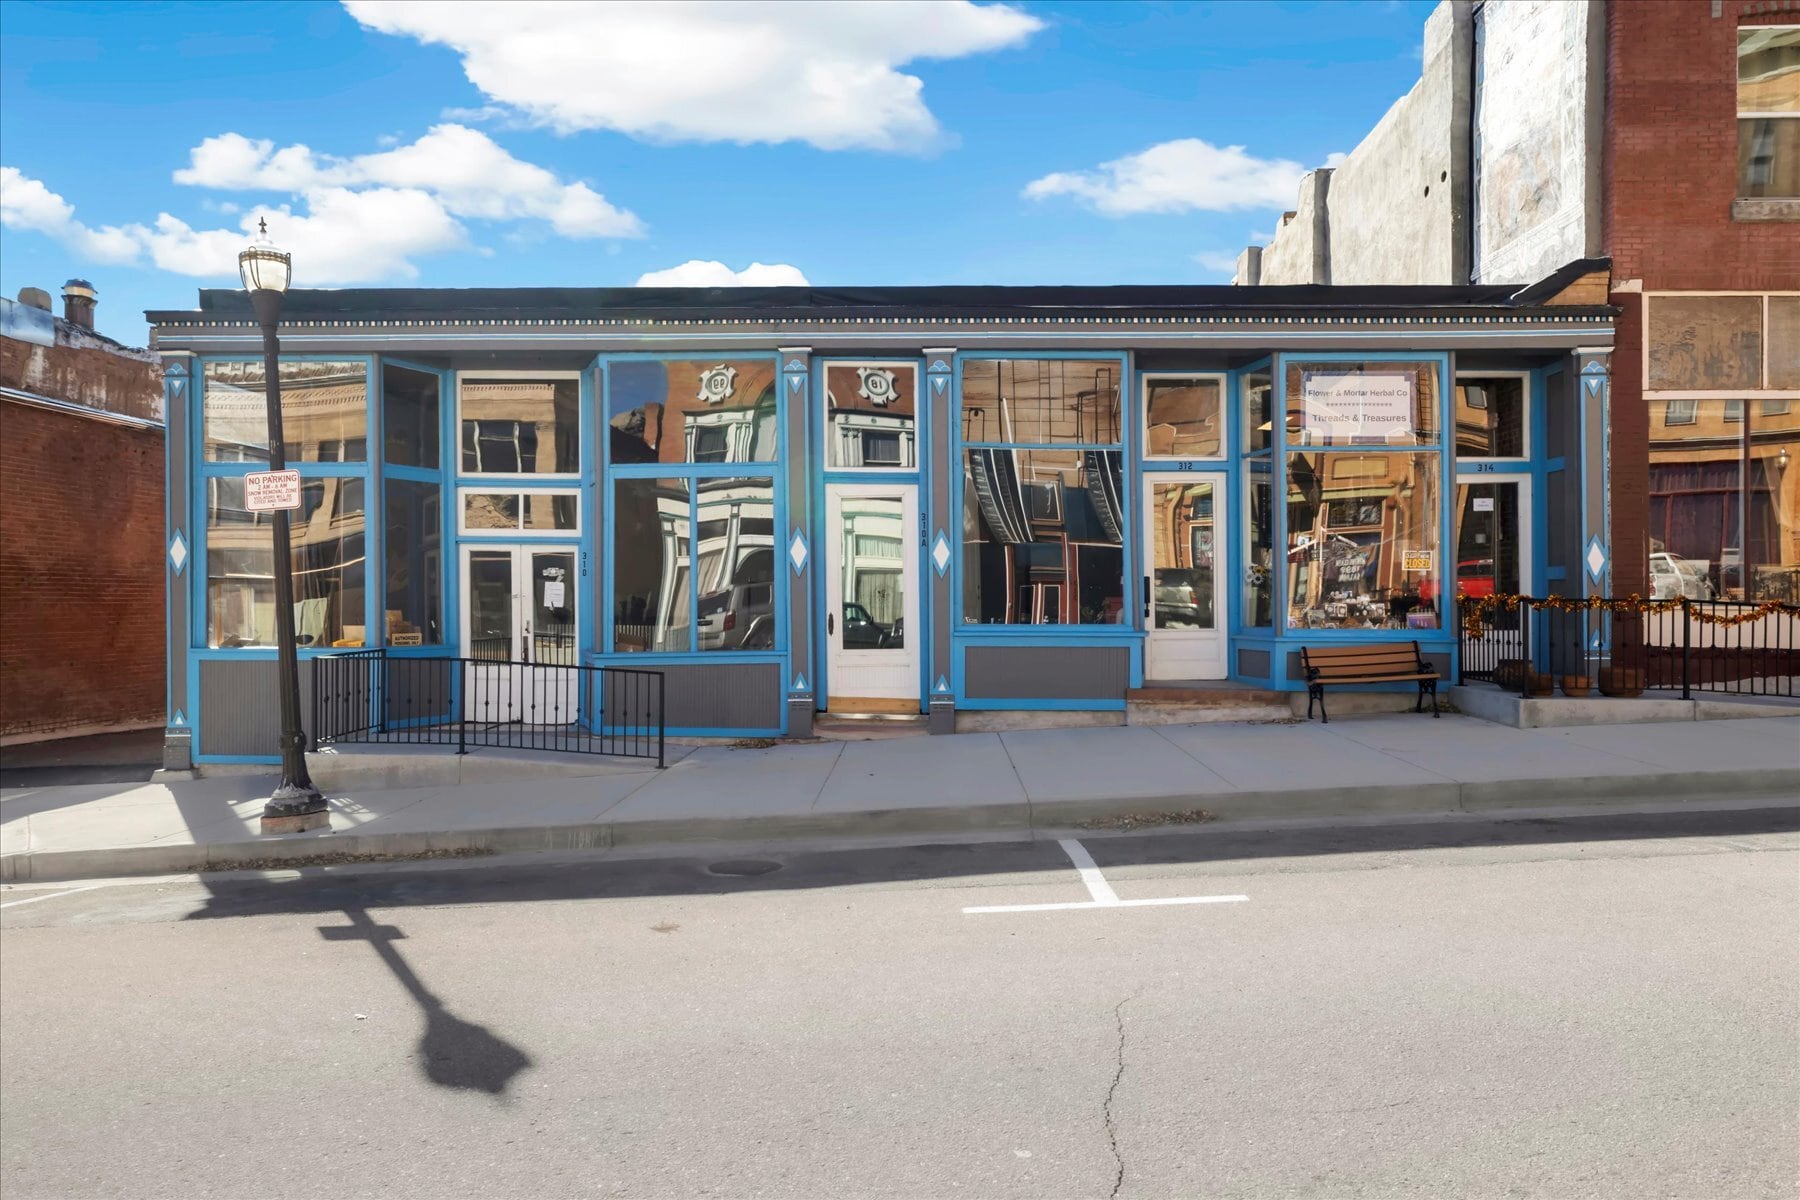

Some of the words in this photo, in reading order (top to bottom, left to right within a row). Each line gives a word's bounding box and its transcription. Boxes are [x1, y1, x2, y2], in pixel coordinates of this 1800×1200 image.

[1312, 414, 1349, 422] Threads
[1352, 414, 1360, 422] &
[1362, 414, 1406, 422] Treasures
[1178, 462, 1192, 470] 312
[1477, 464, 1494, 472] 314
[263, 475, 296, 484] PARKING
[1404, 558, 1430, 569] CLOSED
